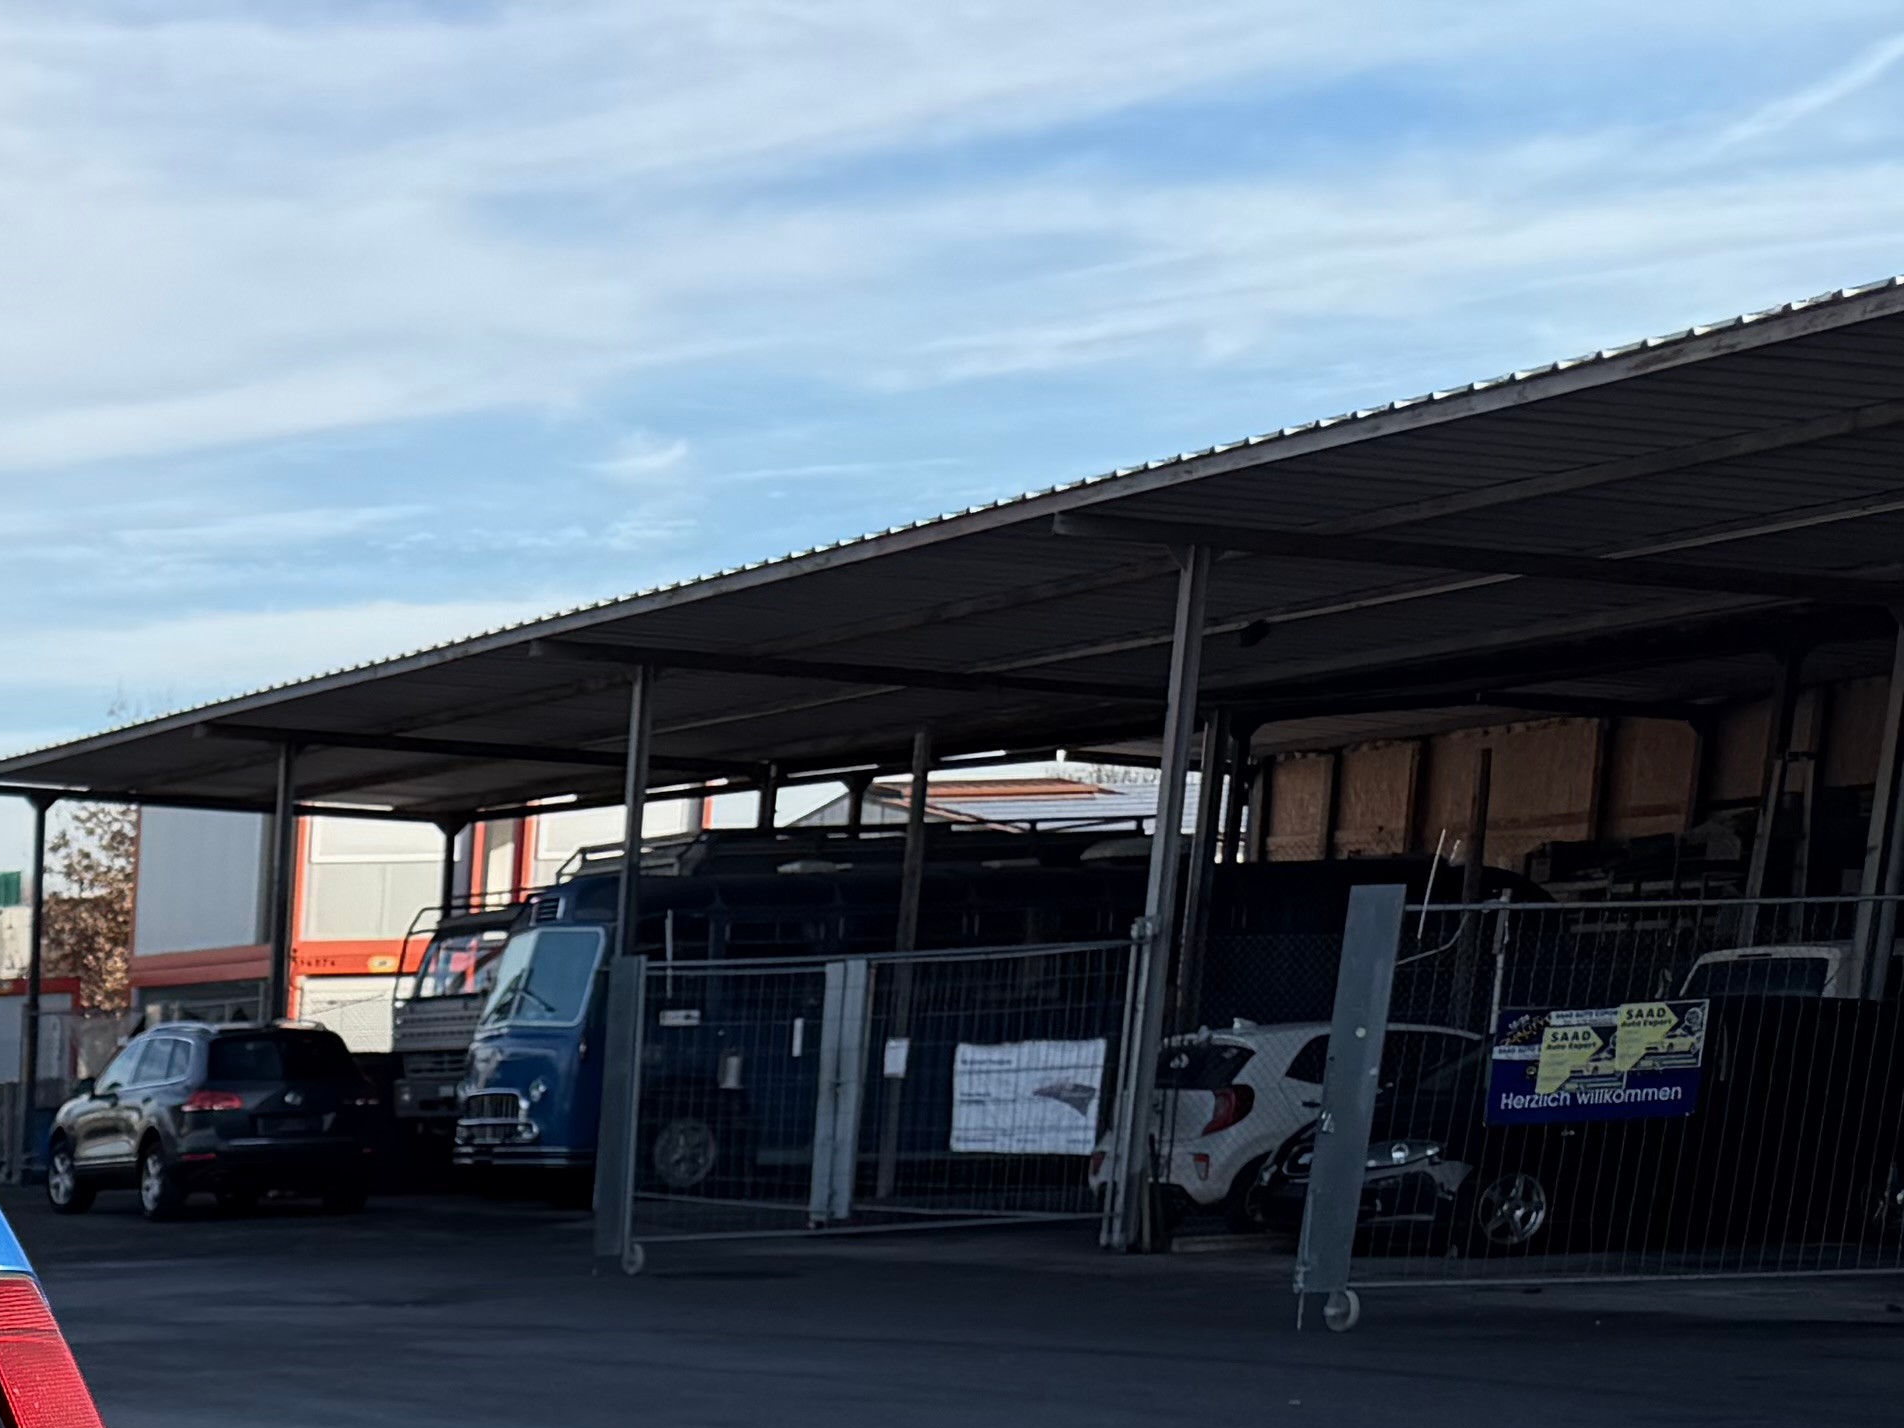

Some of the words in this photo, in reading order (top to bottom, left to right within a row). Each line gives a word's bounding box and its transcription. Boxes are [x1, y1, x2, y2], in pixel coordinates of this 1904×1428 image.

[1625, 1007, 1667, 1020] SAAD
[1550, 1031, 1591, 1042] SAAD
[1500, 1091, 1571, 1110] Herzlich
[1576, 1086, 1682, 1105] willkommen
